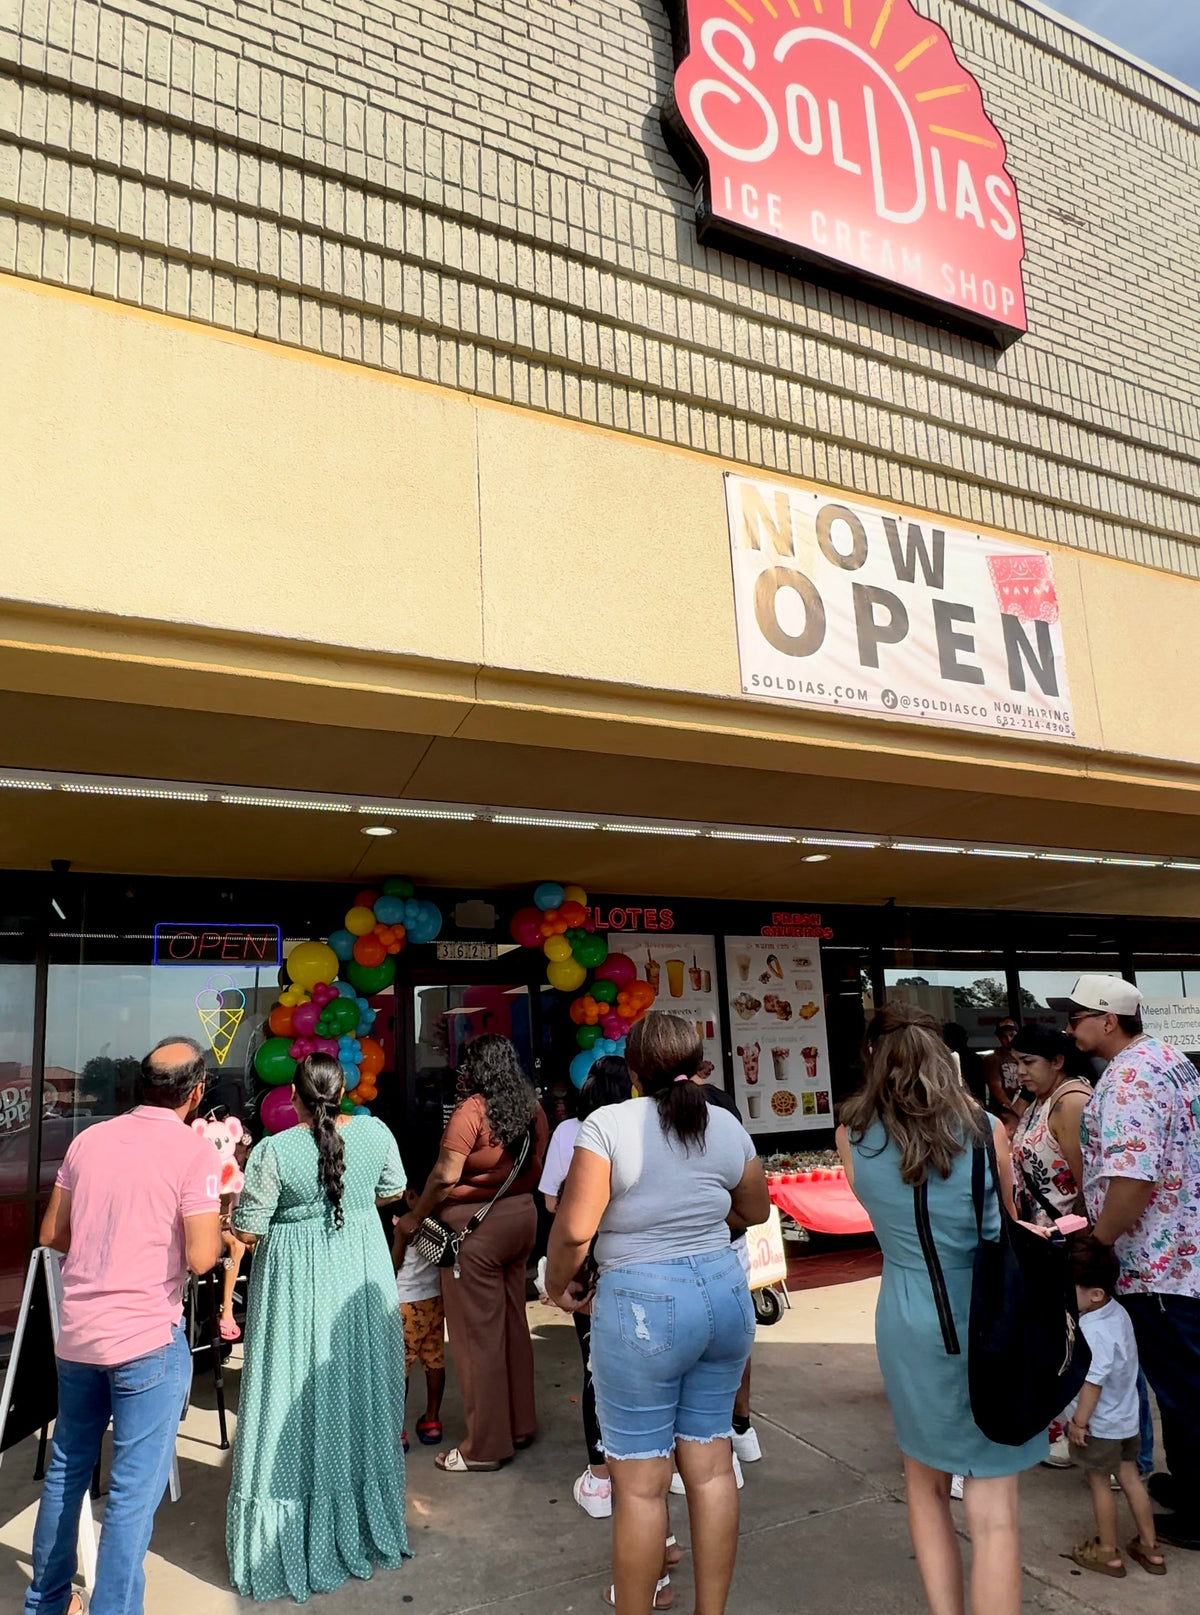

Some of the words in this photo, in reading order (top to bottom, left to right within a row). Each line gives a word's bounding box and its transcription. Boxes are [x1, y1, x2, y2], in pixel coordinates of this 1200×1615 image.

[724, 176, 783, 229] ICE
[811, 210, 923, 284] CREAM
[941, 263, 1014, 315] SHOP
[738, 483, 945, 590] NOW
[754, 565, 1060, 697] OPEN
[751, 674, 869, 702] SOLDIAS.COM
[900, 695, 988, 718] @SOLDIASCO
[993, 701, 1022, 715] NOW
[1027, 706, 1070, 722] HIRING
[772, 912, 821, 926] FRESH
[169, 932, 268, 960] OPEN
[442, 945, 493, 958] 3621
[1142, 1004, 1171, 1015] Meenal
[1172, 1003, 1200, 1014] Thirtha
[1143, 1021, 1162, 1031] amily
[1163, 1034, 1200, 1045] 972-252-5
